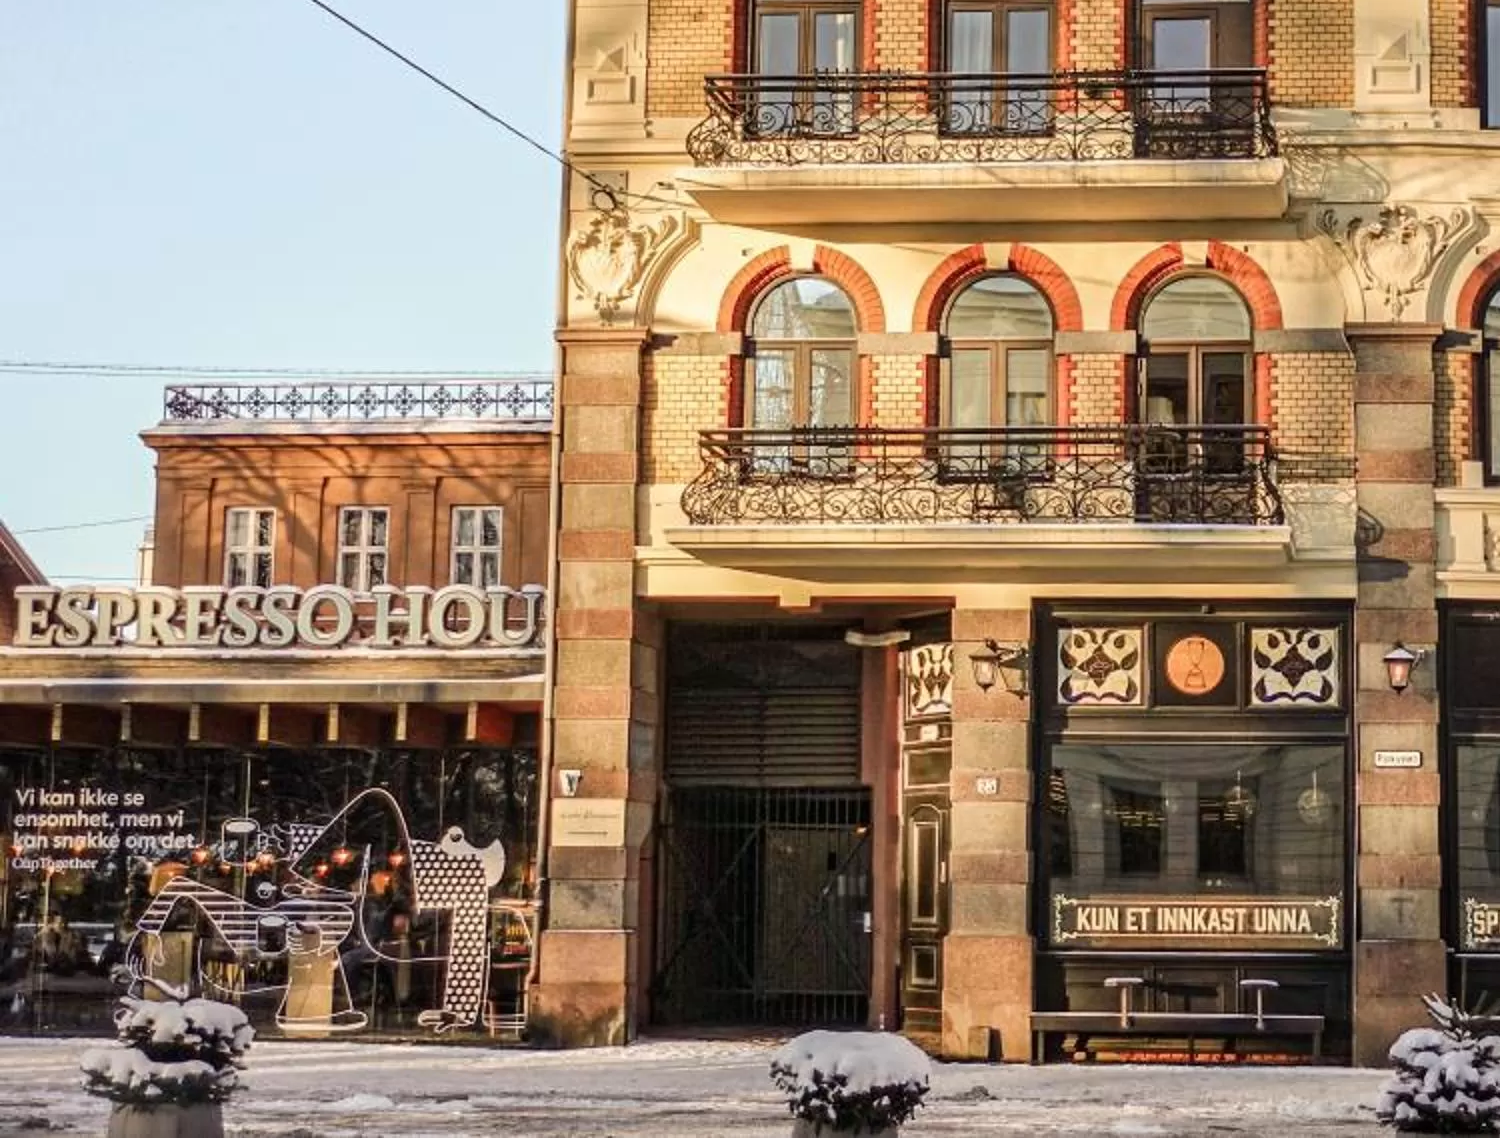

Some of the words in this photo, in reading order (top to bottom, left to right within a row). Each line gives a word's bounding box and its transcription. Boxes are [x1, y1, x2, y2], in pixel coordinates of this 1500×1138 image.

[13, 585, 353, 648] ESPRESSO
[15, 788, 35, 806] Vi
[39, 788, 75, 806] kan
[79, 788, 119, 806] ikke
[123, 792, 145, 806] se
[13, 810, 115, 829] ensomhet,
[119, 814, 162, 828] men
[167, 810, 184, 828] vi
[13, 832, 48, 850] kan
[52, 832, 120, 850] snakke
[125, 835, 156, 850] om
[1077, 906, 1119, 932] KUN
[1125, 906, 1150, 932] ET
[1157, 906, 1246, 932] INNKAST
[1253, 907, 1312, 932] UNNA
